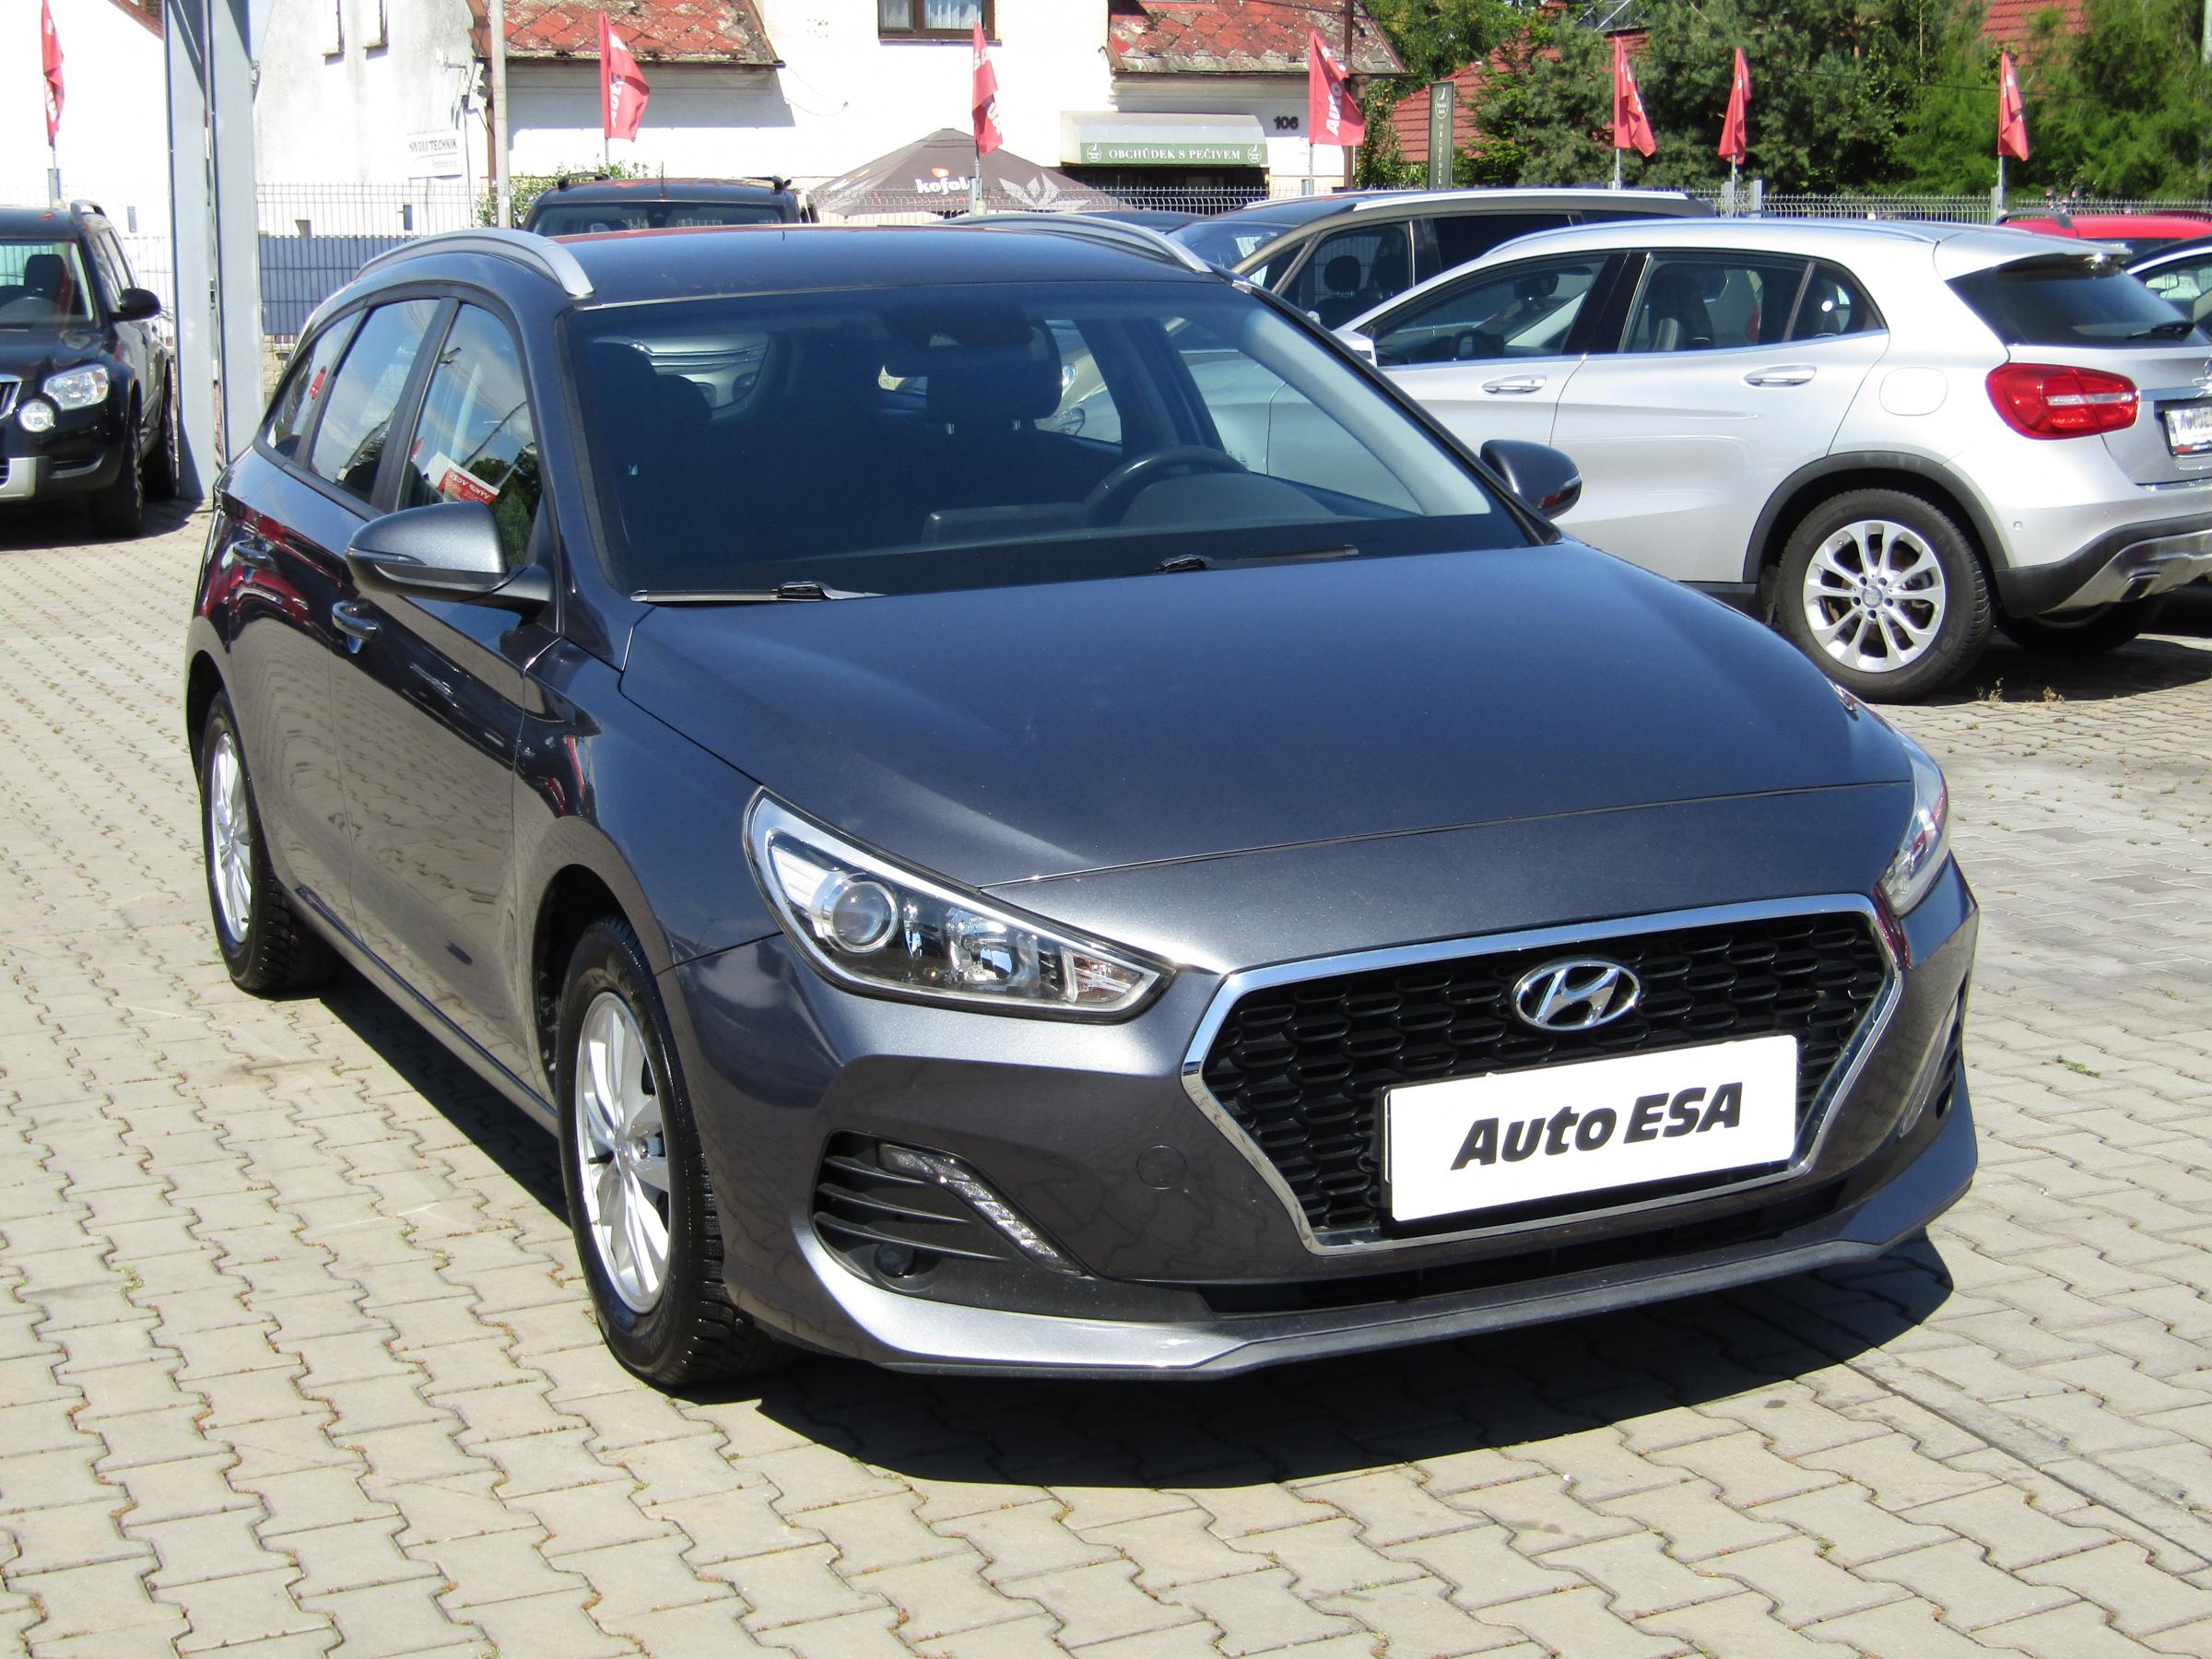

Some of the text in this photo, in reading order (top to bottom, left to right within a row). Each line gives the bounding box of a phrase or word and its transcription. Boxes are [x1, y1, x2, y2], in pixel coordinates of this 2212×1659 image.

[1109, 147, 1176, 159] OBCHŮDEK
[1178, 148, 1186, 160] S
[1189, 147, 1241, 160] PEČIVEM
[914, 176, 971, 195] kofol
[1450, 1081, 1743, 1171] Auto ESA
